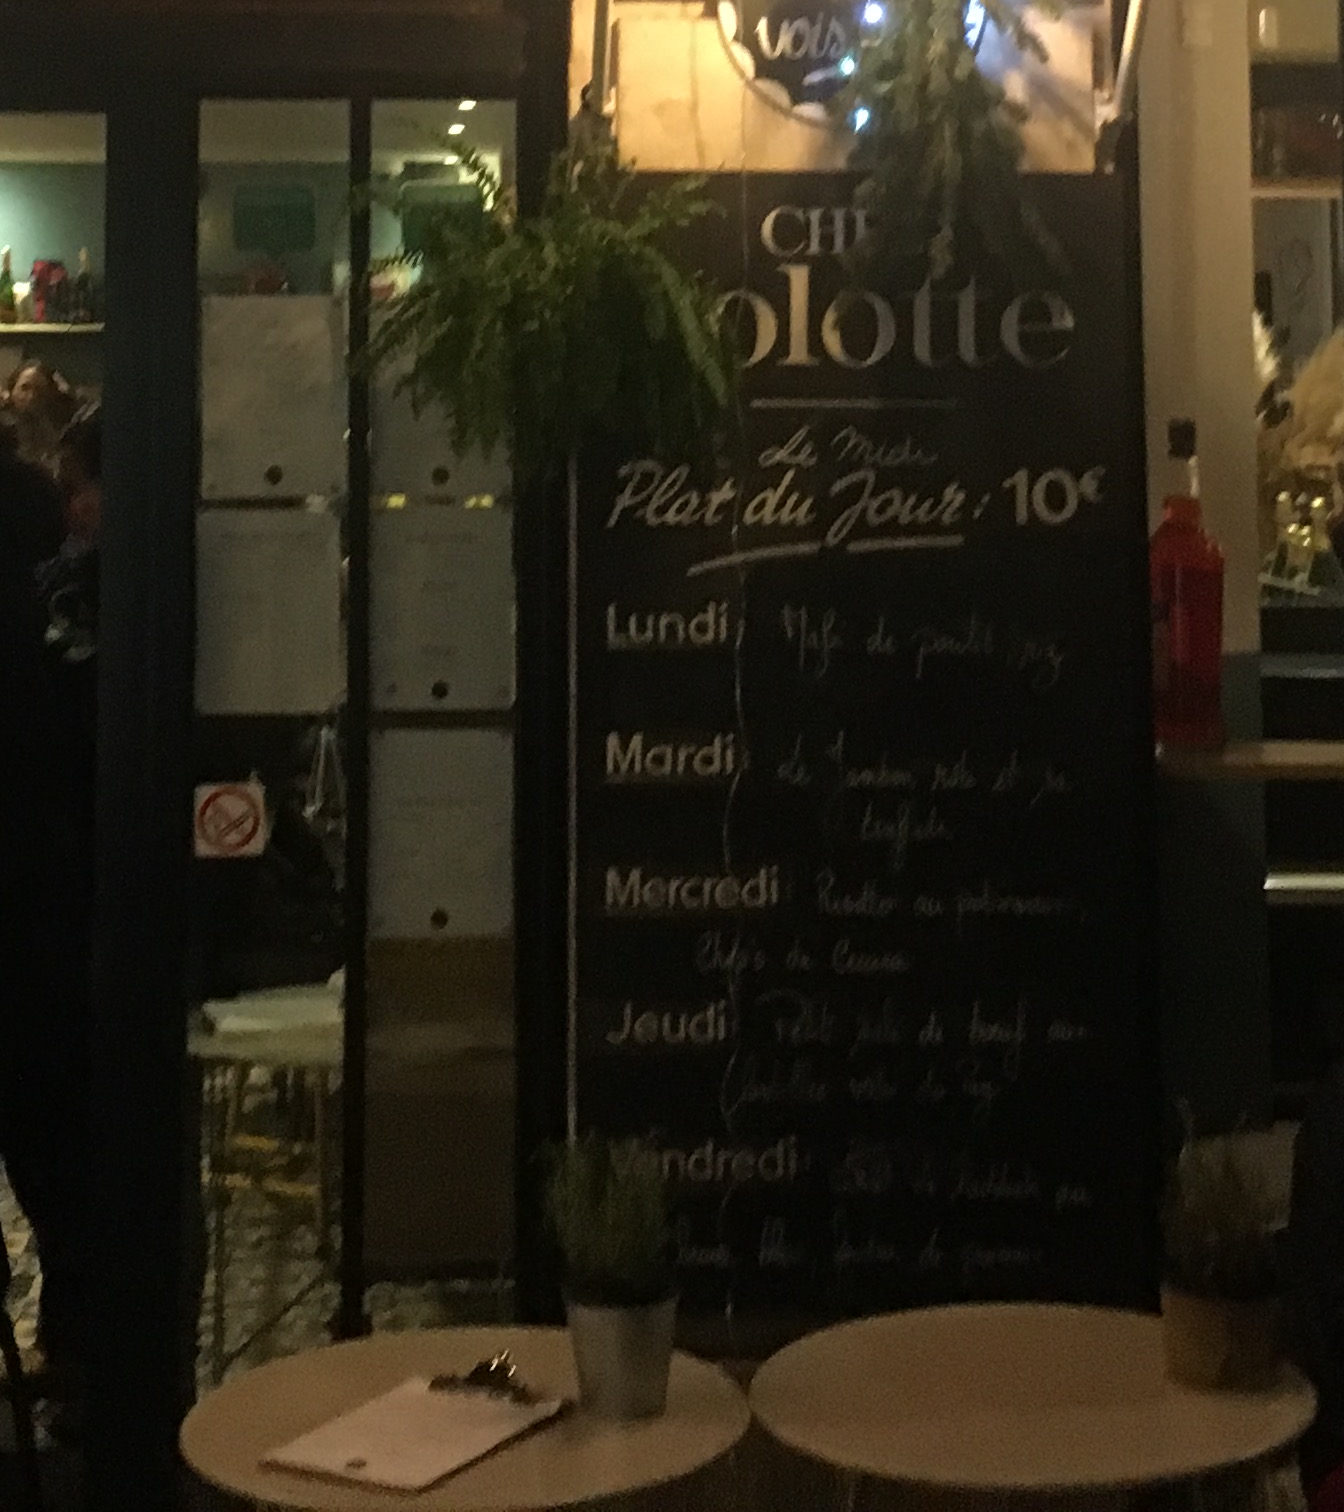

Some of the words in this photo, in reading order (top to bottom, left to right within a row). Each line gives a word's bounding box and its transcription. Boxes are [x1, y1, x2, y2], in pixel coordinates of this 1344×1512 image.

[710, 263, 1076, 369] olotte
[607, 459, 736, 529] Plat
[742, 469, 817, 528] du
[605, 600, 729, 650] Lundi
[605, 731, 736, 778] Mardi
[605, 997, 727, 1045] Jeudi
